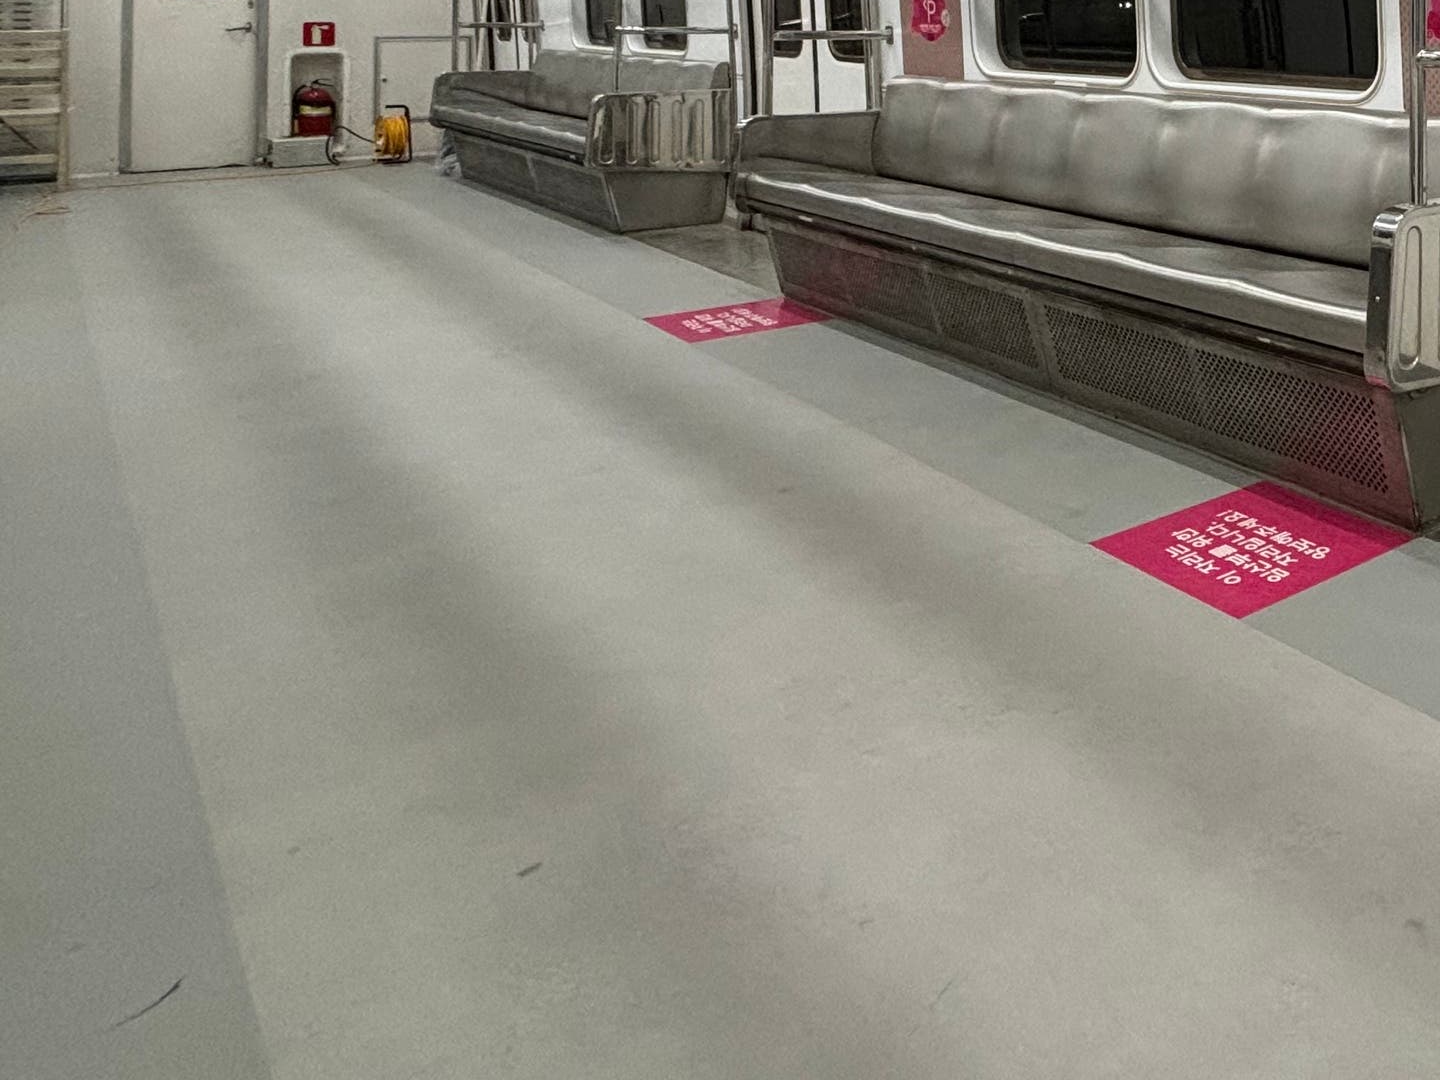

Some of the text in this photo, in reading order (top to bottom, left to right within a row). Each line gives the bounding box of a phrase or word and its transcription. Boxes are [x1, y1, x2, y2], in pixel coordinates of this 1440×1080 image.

[1165, 544, 1242, 584] 이 자리는
[1171, 528, 1290, 582] 임산부를 위한
